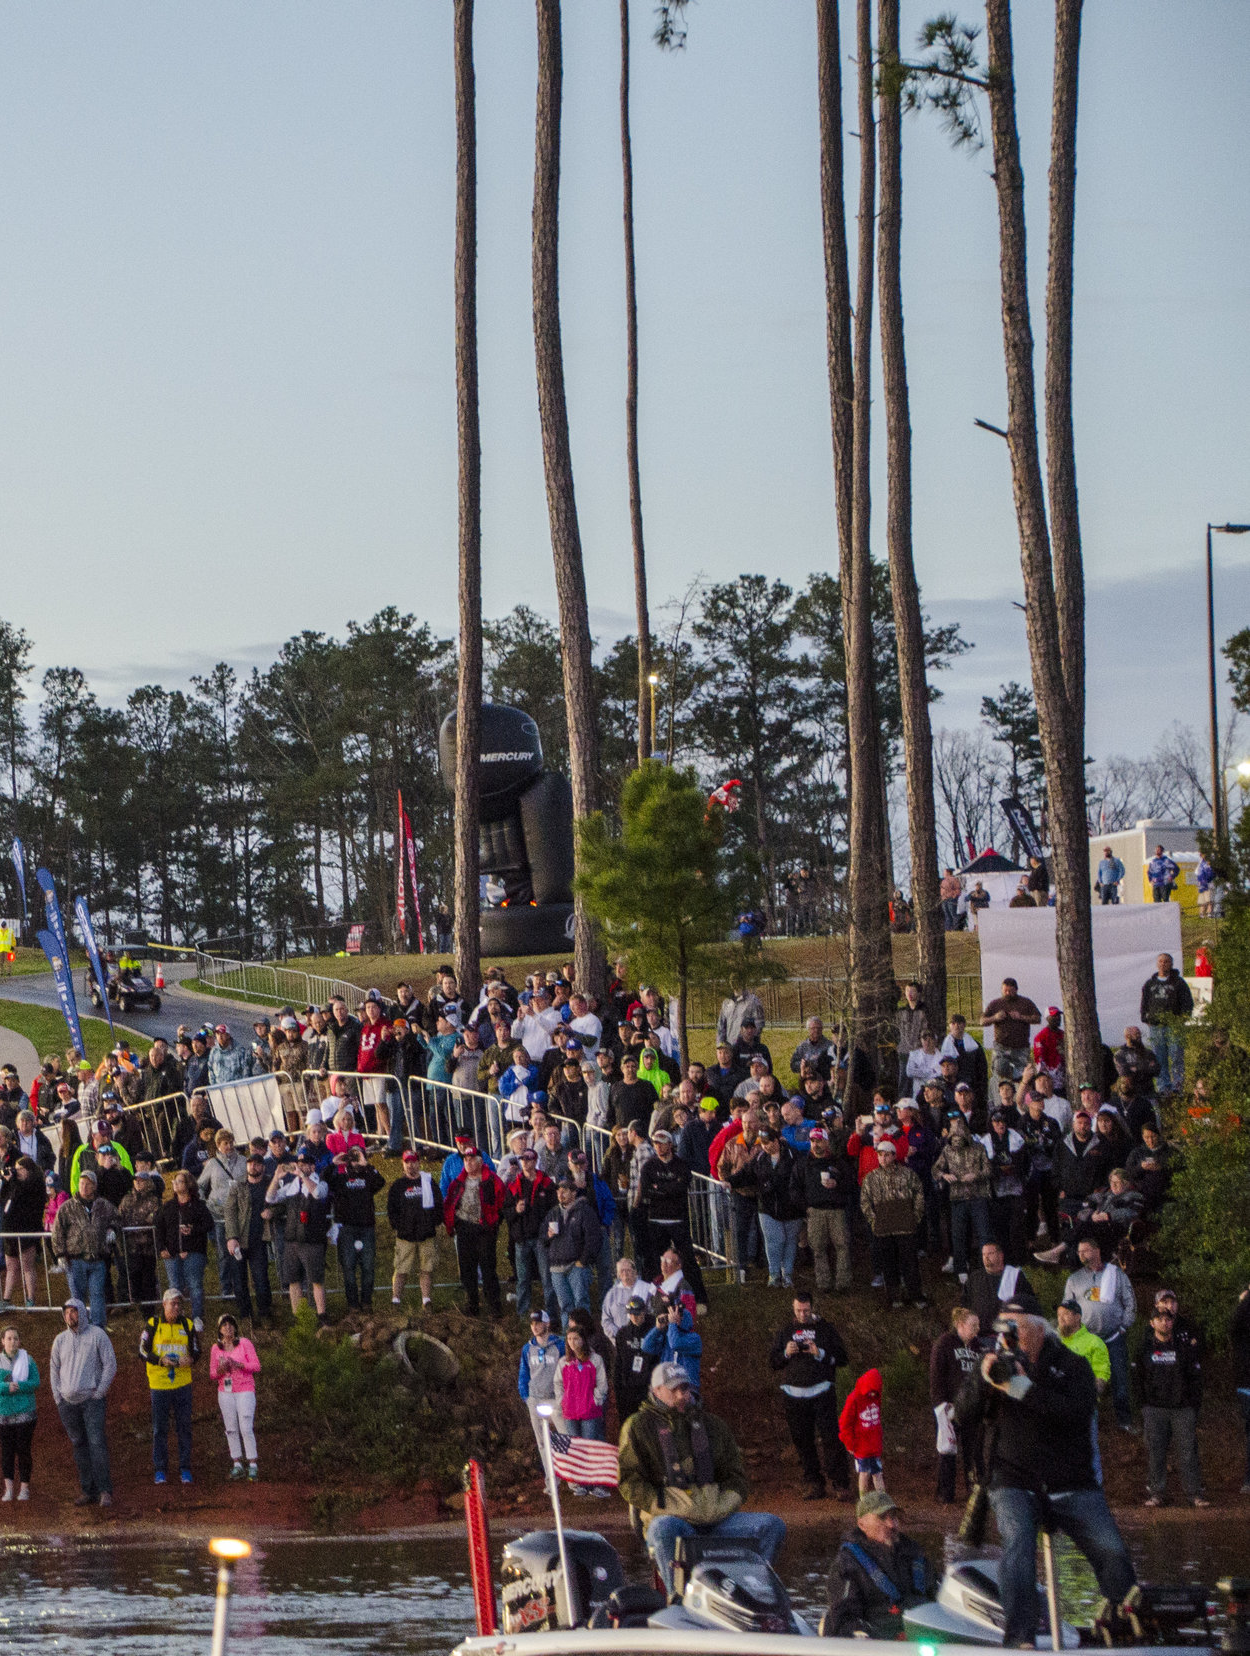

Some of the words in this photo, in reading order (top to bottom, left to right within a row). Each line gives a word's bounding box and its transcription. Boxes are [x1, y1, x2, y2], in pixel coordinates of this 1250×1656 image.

[479, 751, 534, 763] MERCURY
[1012, 809, 1043, 858] NITRO
[501, 1567, 564, 1604] MERCURY
